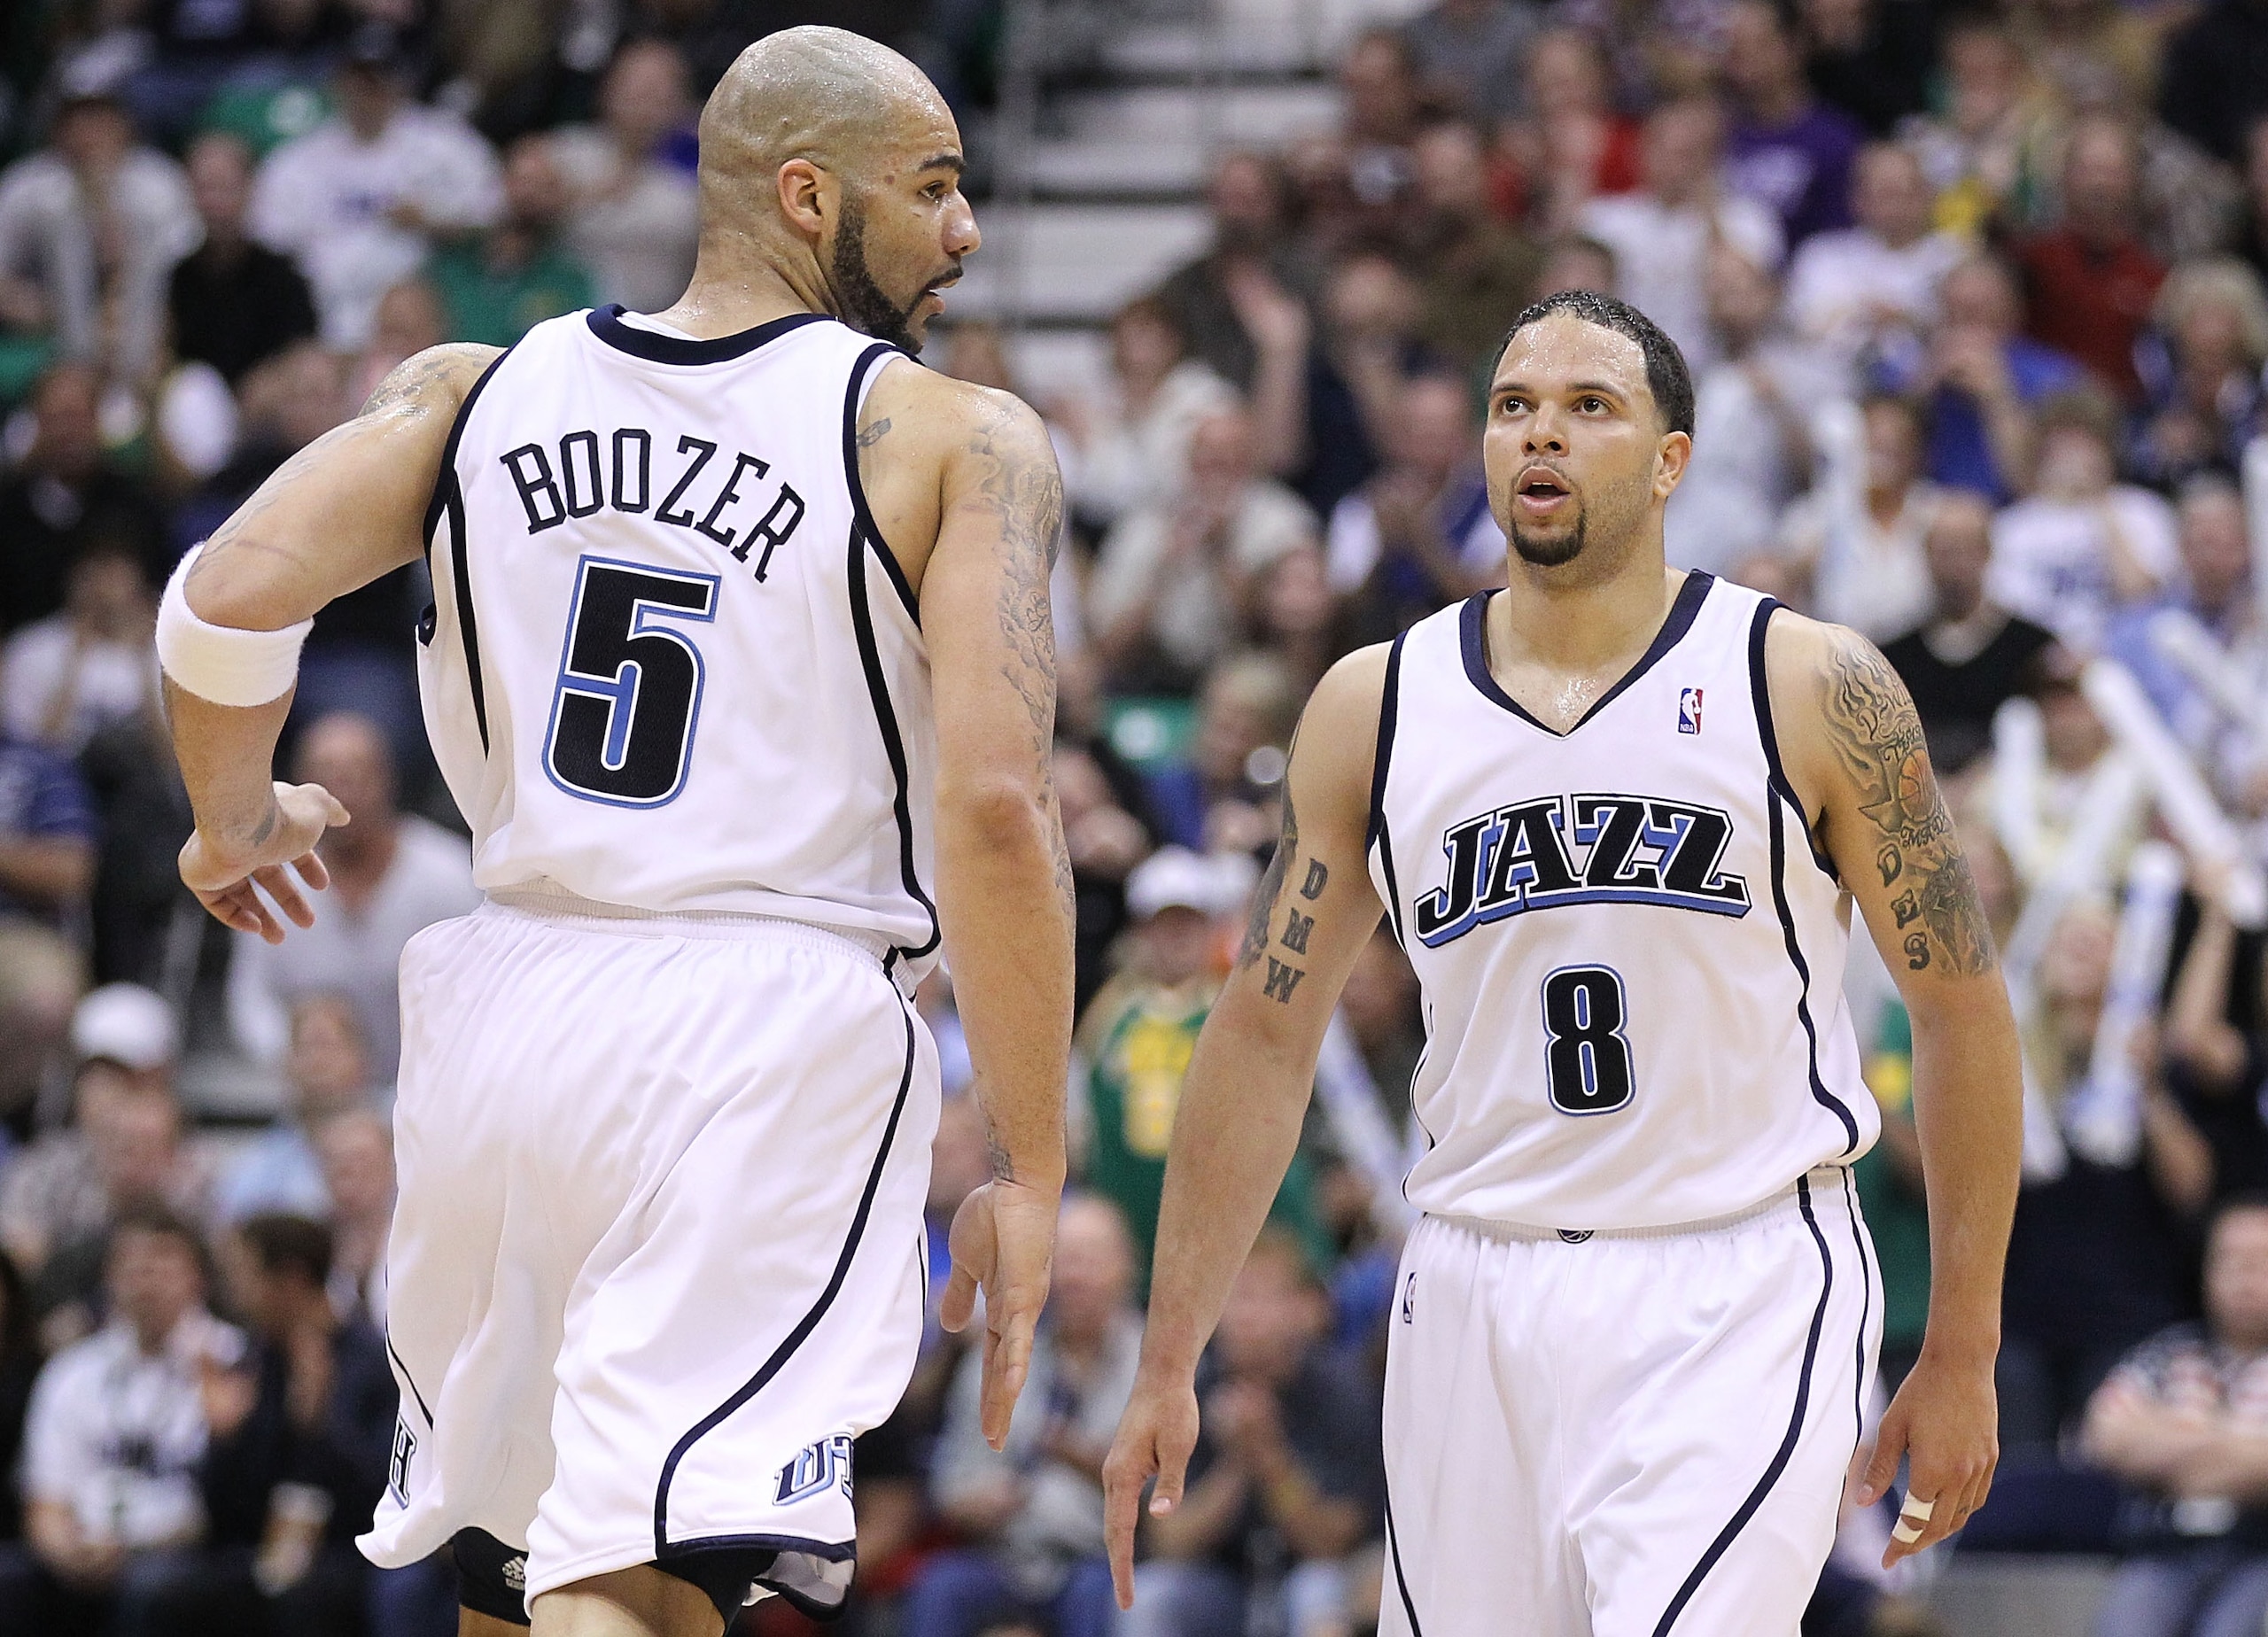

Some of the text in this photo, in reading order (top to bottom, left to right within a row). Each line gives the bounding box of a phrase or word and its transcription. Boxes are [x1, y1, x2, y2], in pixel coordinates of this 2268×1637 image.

[500, 428, 805, 583] BOOZER
[541, 554, 722, 810] 5
[1414, 793, 1751, 949] JAZZ
[1541, 963, 1636, 1117] 8
